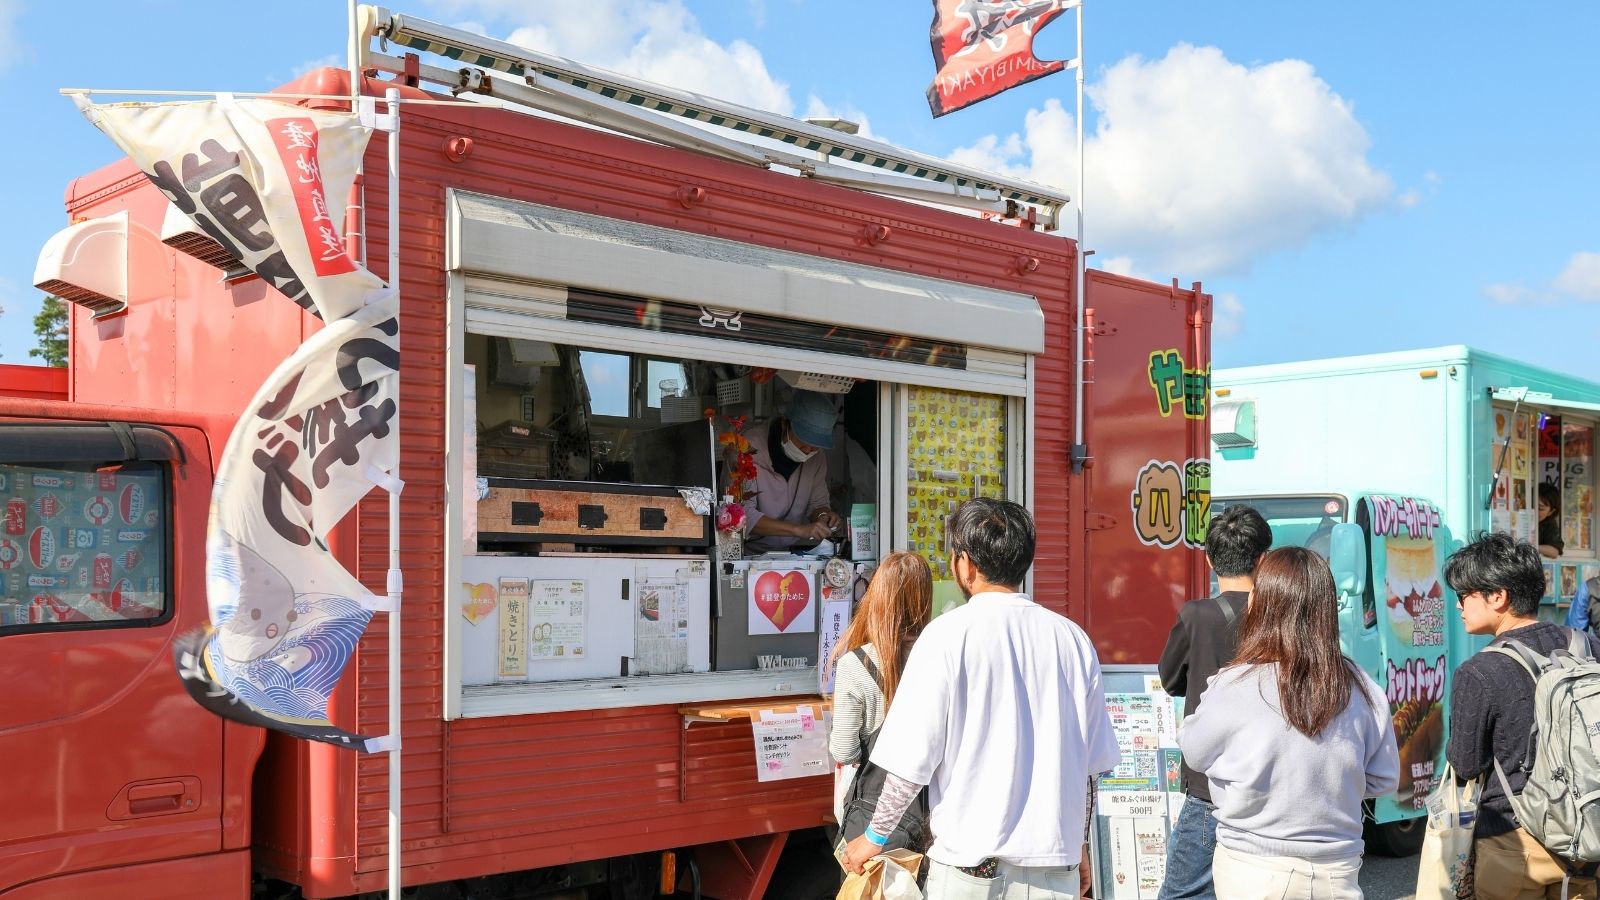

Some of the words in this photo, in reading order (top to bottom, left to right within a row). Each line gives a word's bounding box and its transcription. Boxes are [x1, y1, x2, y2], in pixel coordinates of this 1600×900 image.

[1545, 461, 1584, 475] PUG
[760, 592, 804, 602] #能登のために
[507, 600, 519, 656] 焼きとり
[757, 655, 808, 670] Welcome
[1386, 655, 1445, 703] ホットドッグ
[1104, 705, 1124, 713] enu
[1157, 706, 1165, 734] 800円
[1111, 795, 1162, 804] 能登ふぐ串揚げ
[1129, 807, 1153, 815] 500円
